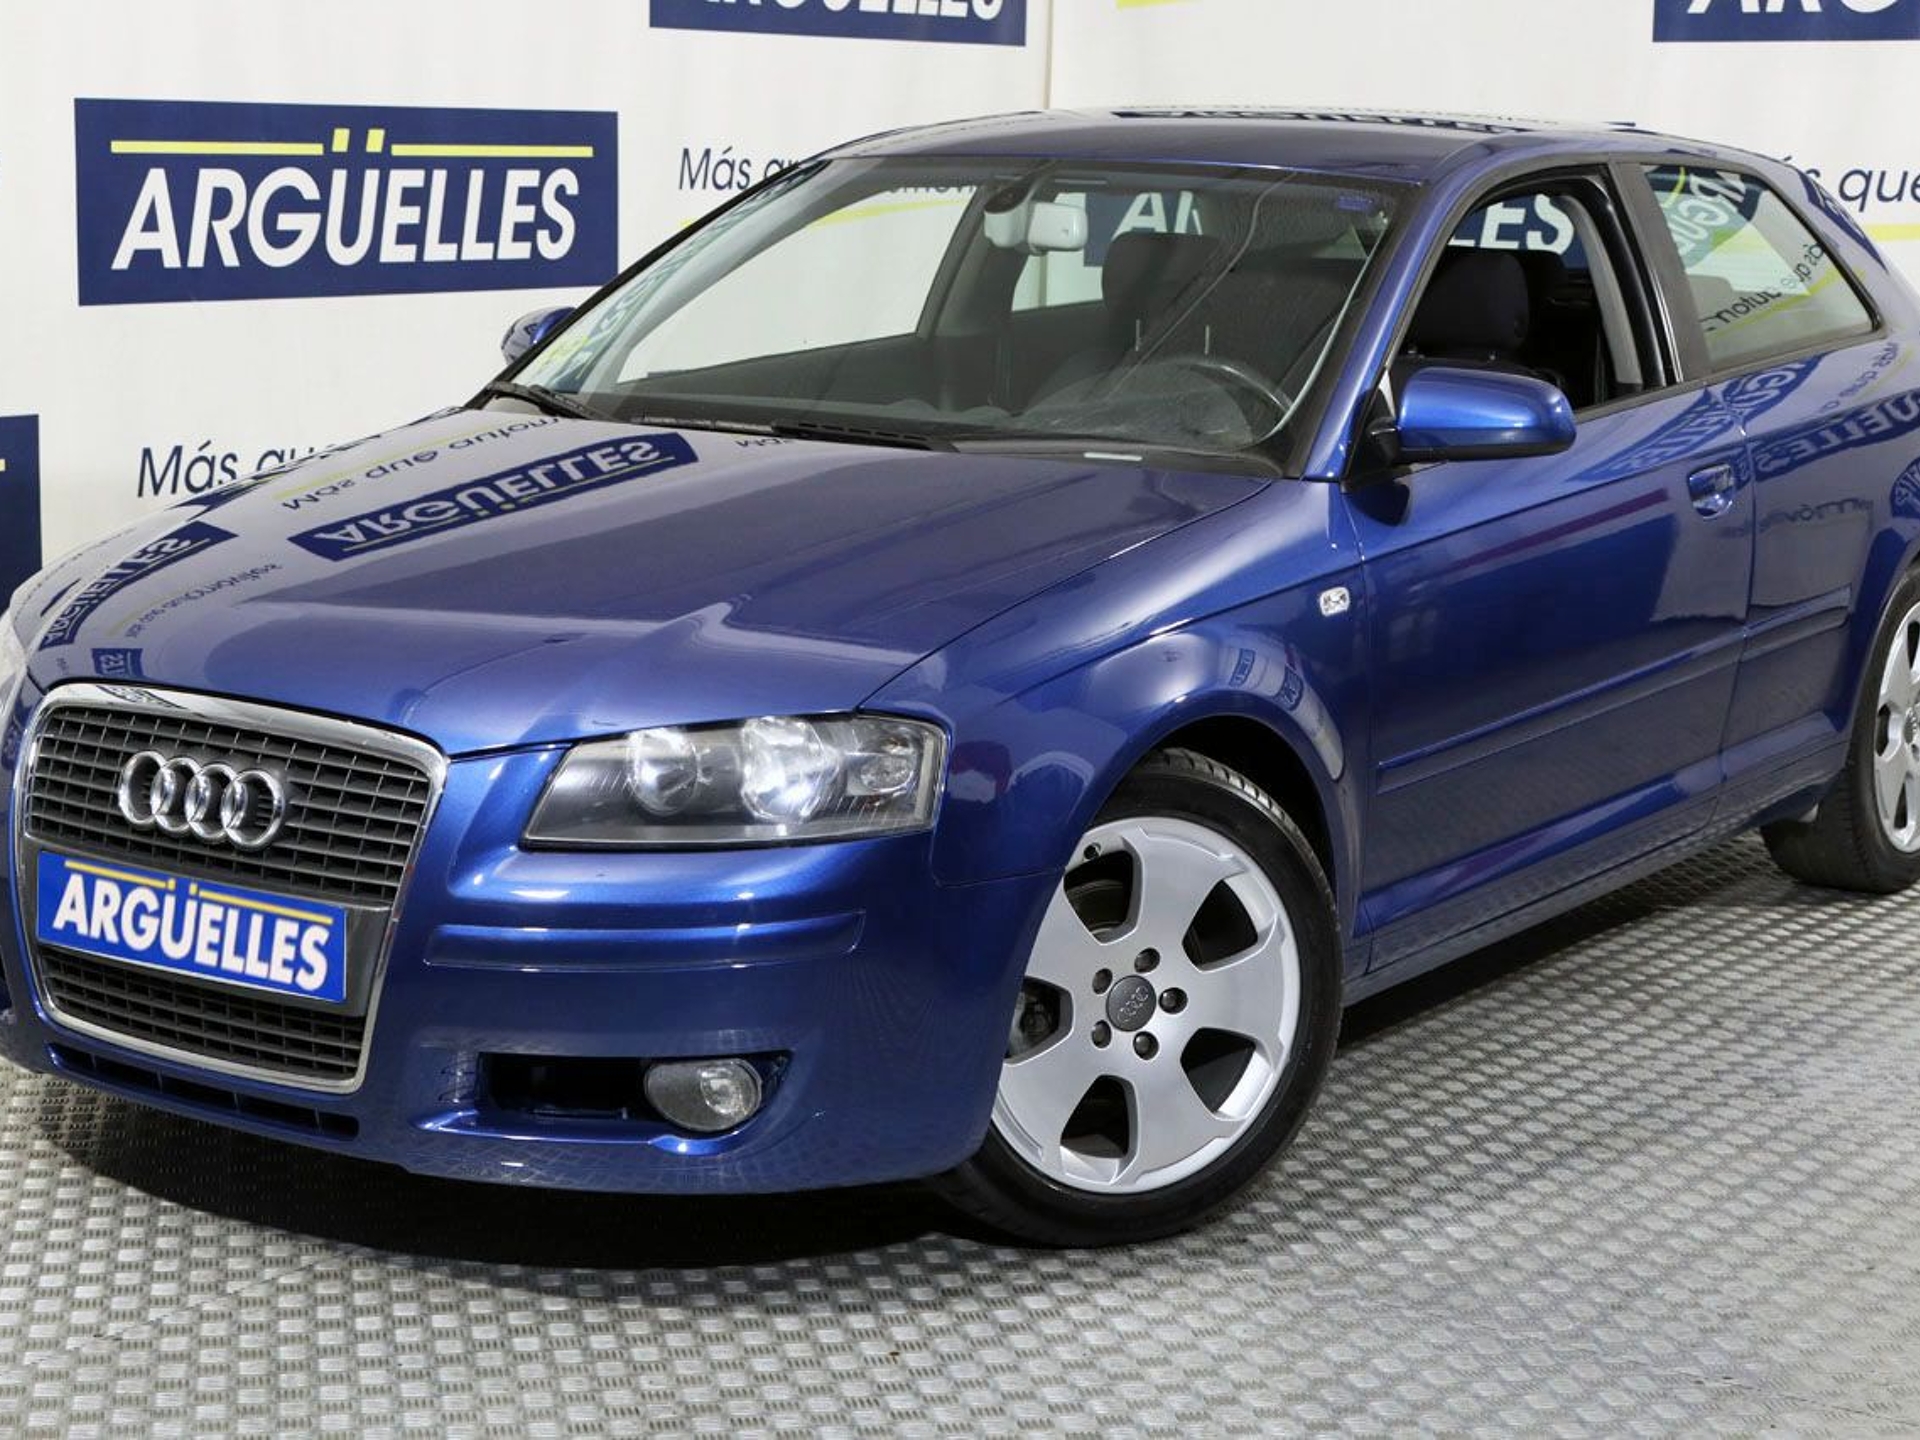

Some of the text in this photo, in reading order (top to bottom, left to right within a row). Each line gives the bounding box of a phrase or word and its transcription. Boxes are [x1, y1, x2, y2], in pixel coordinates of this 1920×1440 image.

[111, 127, 579, 271] ARGÜELLES
[678, 146, 751, 190] Más
[137, 440, 239, 498] Más
[52, 873, 331, 991] ARGÜELLES
